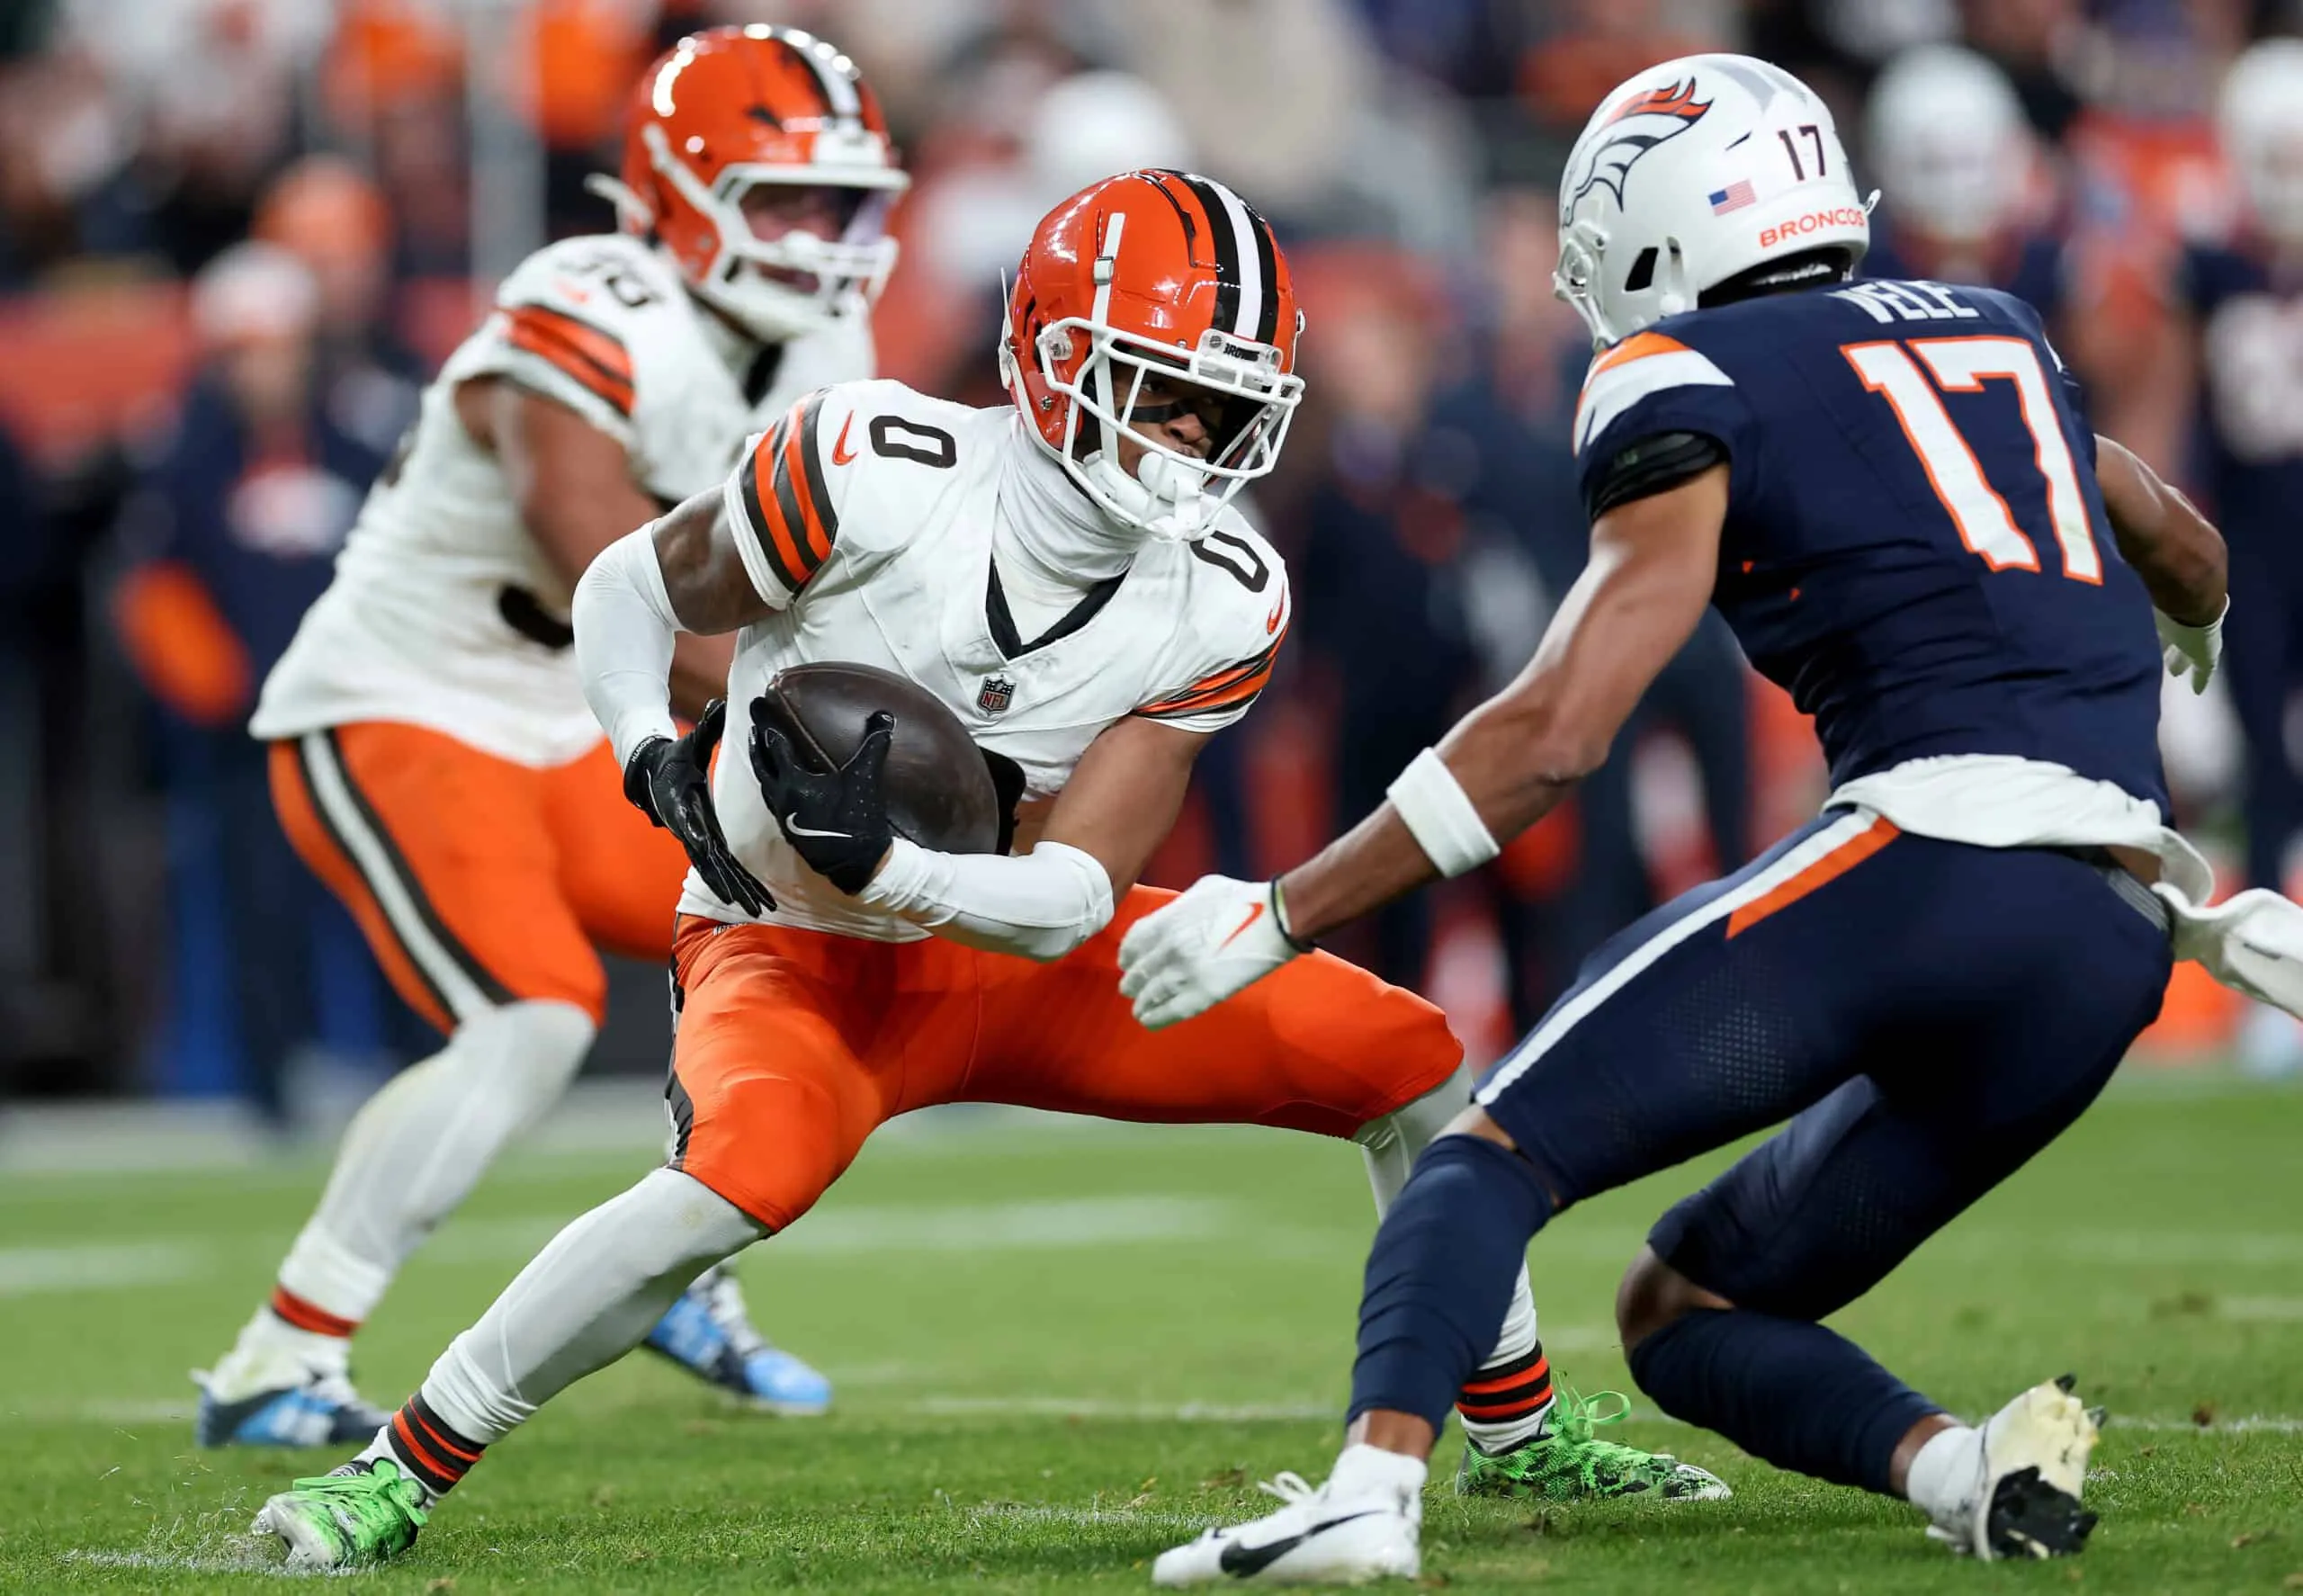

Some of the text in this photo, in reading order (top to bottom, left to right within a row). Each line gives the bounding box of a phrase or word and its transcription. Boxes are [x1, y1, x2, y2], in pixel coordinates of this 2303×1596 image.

[1777, 124, 1826, 182] 17
[1760, 208, 1866, 247] BRONCOS
[1824, 280, 1979, 324] VELE
[869, 415, 956, 469] 0
[1839, 334, 2103, 586] 17
[1189, 530, 1269, 593] 0
